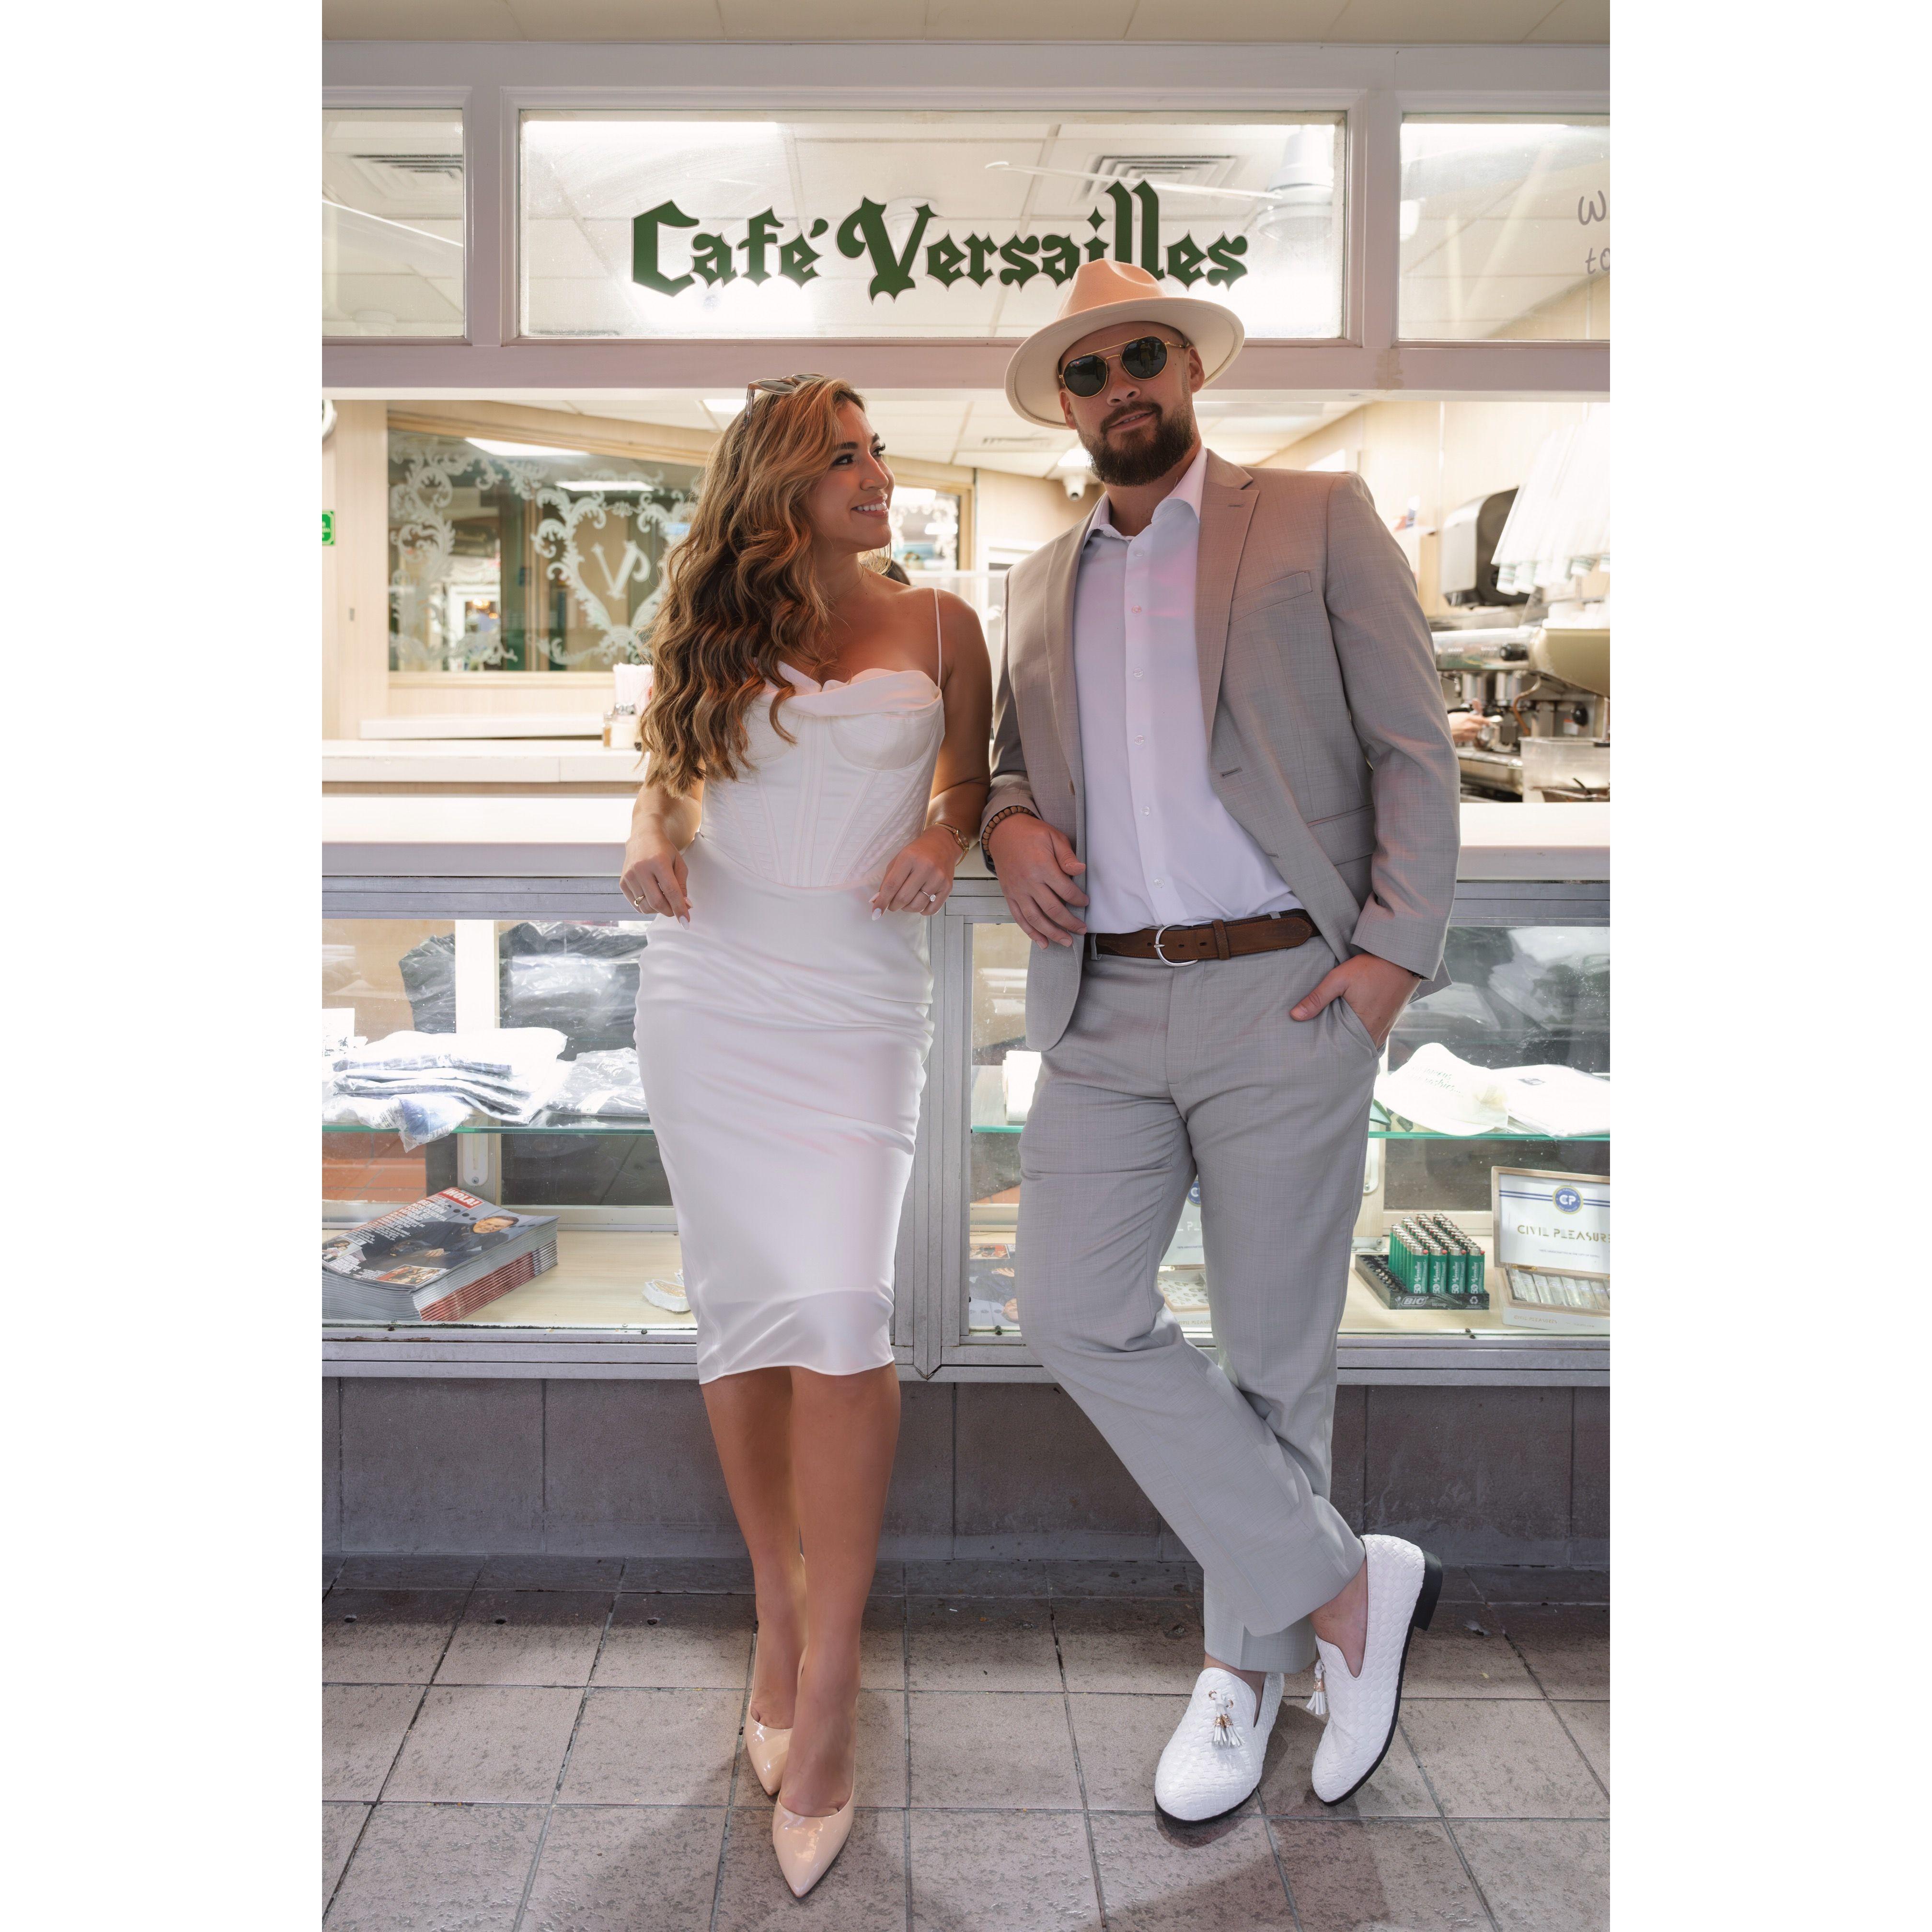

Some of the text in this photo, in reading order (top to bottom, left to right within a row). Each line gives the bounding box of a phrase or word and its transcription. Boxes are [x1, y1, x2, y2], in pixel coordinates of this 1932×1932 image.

[835, 178, 1248, 304] Versailles
[1559, 1194, 1576, 1205] CP
[1517, 1225, 1549, 1237] CIVIL
